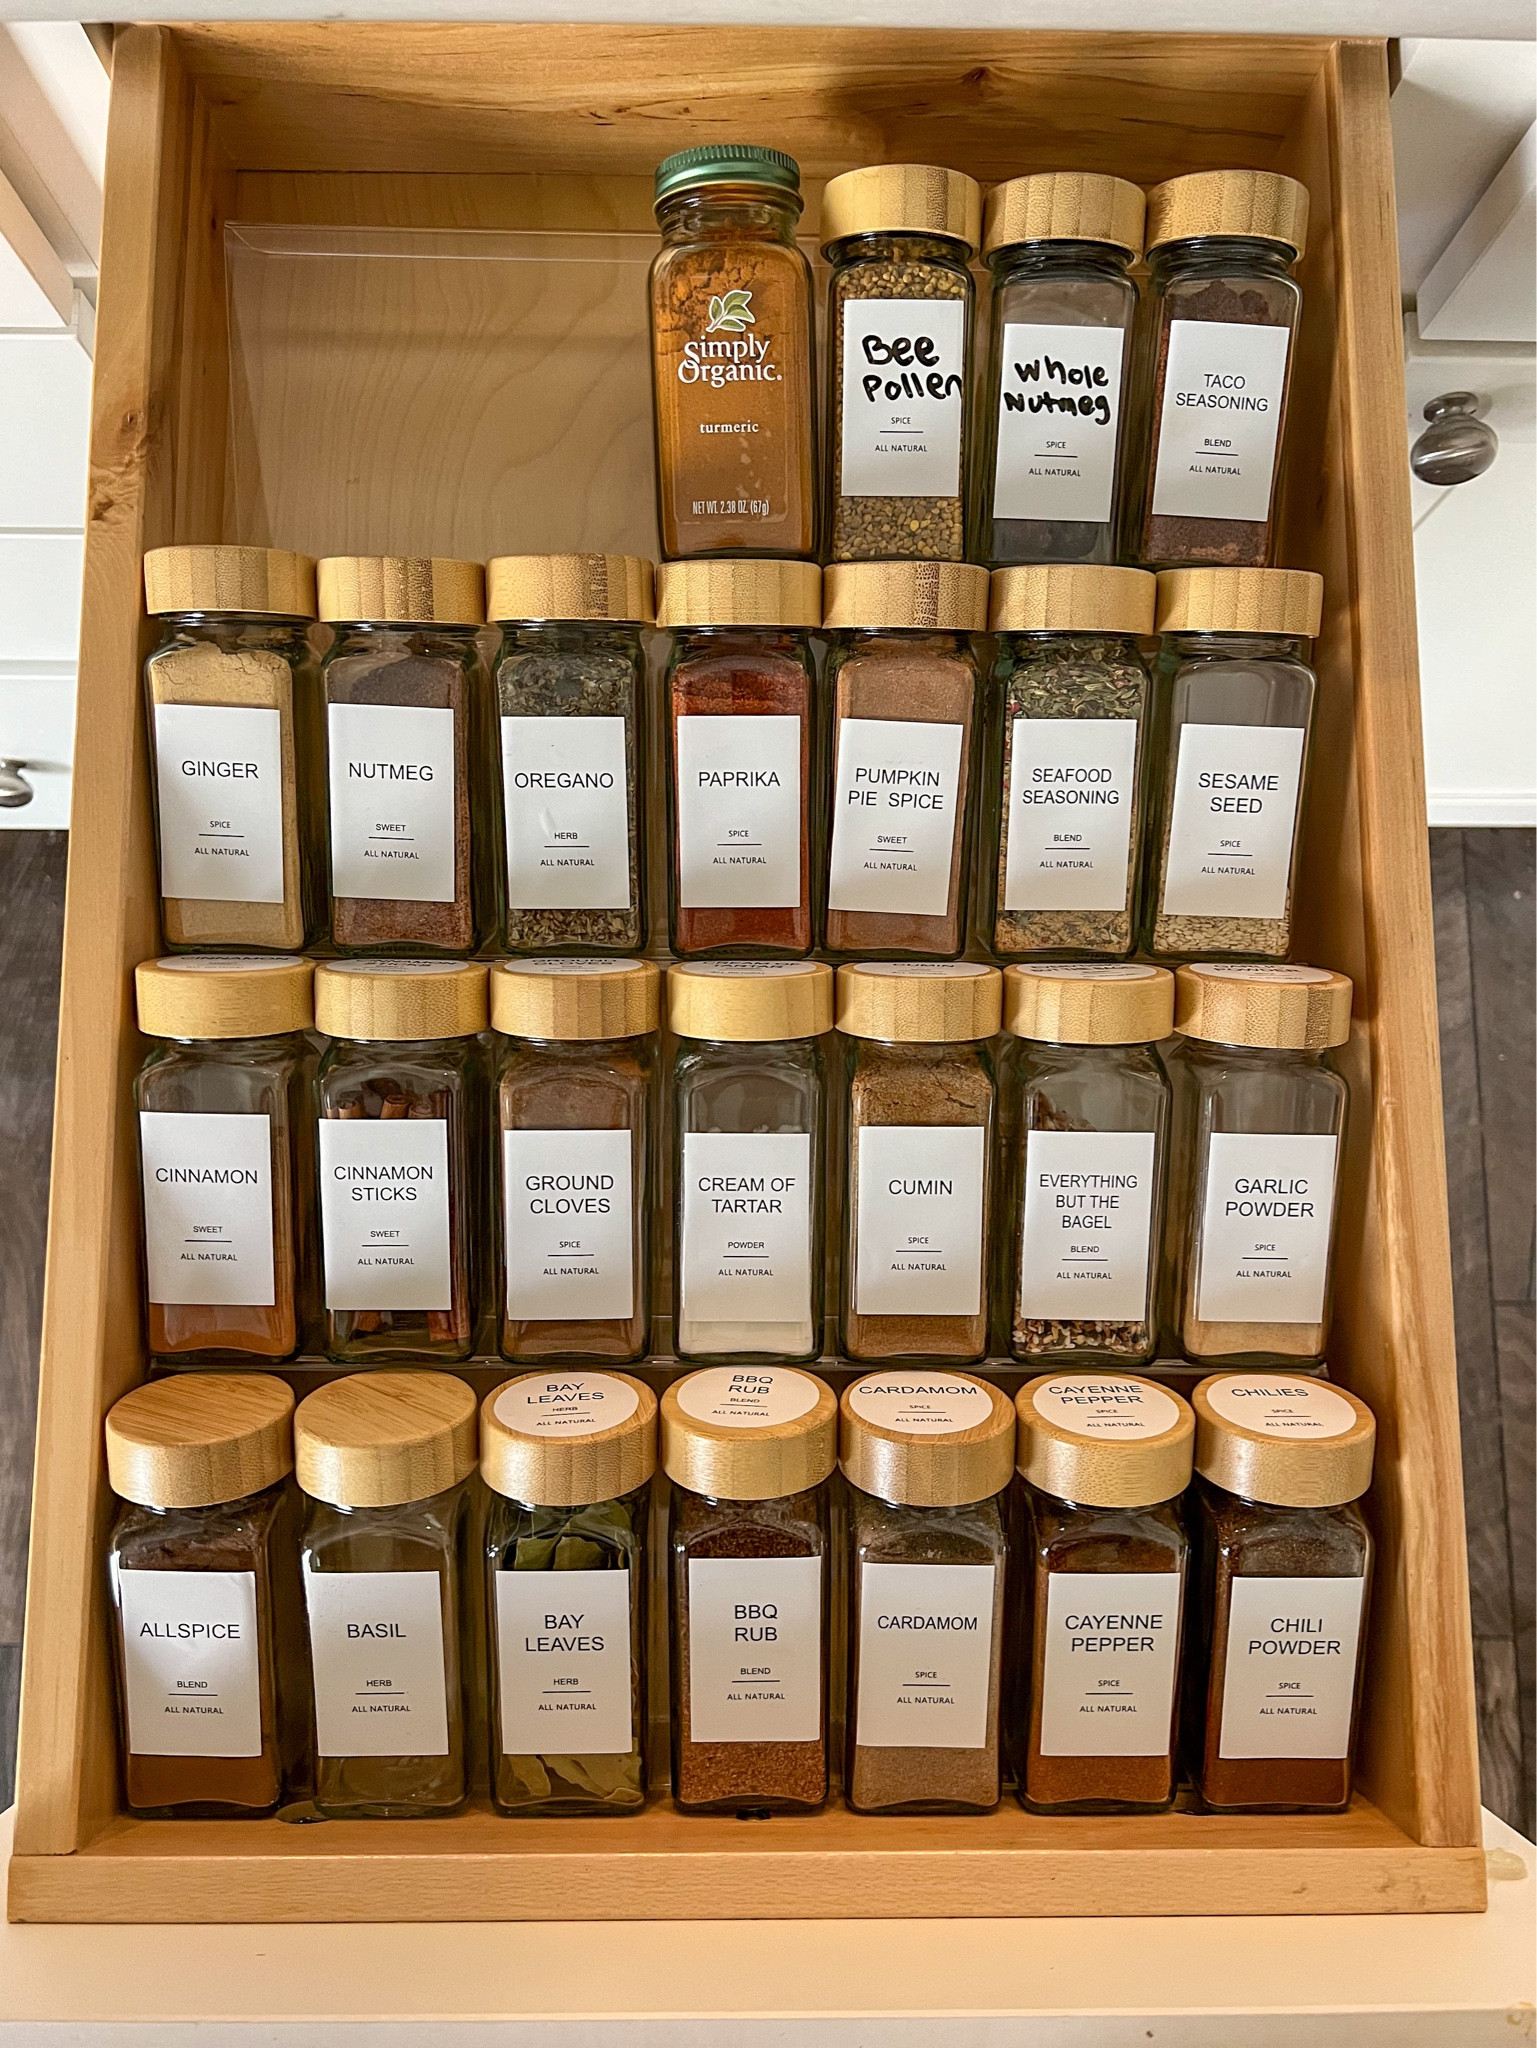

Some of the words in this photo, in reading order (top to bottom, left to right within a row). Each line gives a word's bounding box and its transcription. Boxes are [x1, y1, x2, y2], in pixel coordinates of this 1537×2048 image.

[684, 333, 770, 367] Simply
[862, 335, 940, 367] Bee
[1204, 374, 1245, 389] TACO
[862, 373, 963, 402] Pollen
[1176, 392, 1268, 411] SEASONING
[1003, 391, 1111, 425] Nutmeg
[890, 416, 912, 425] SPICE
[700, 420, 759, 435] turmeric
[1045, 440, 1067, 450] SPICE
[1203, 437, 1232, 448] BLEND
[874, 444, 889, 453] ALL
[890, 444, 928, 453] NATURAL
[1027, 467, 1043, 476] ALL
[1044, 467, 1082, 478] NATURAL
[1188, 464, 1204, 474] ALL
[1204, 465, 1242, 476] NATURAL
[692, 500, 705, 515] NET
[720, 499, 737, 514] 2.38
[750, 499, 770, 516] (67g)
[182, 760, 259, 779] GINGER
[349, 762, 433, 781] NUTMEG
[515, 773, 613, 788] OREGANO
[699, 771, 780, 787] PAPRIKA
[856, 768, 939, 786] PUMPKIN
[1032, 768, 1112, 783] SEAFOOD
[1198, 773, 1279, 790] SESAME
[848, 790, 877, 806] PIE
[888, 792, 943, 809] SPICE
[1022, 790, 1119, 804] SEASONING
[1210, 797, 1262, 813] SEED
[209, 820, 232, 829] SPICE
[375, 822, 407, 833] SWEET
[553, 831, 579, 840] HERB
[727, 829, 750, 838] SPICE
[1053, 833, 1083, 843] BLEND
[876, 834, 908, 845] SWEET
[1219, 839, 1242, 848] SPICE
[193, 846, 210, 856] ALL
[210, 847, 251, 857] NATURAL
[363, 849, 379, 858] ALL
[380, 850, 420, 860] NATURAL
[539, 858, 555, 867] ALL
[556, 858, 596, 867] NATURAL
[712, 856, 728, 865] ALL
[729, 856, 768, 865] NATURAL
[1039, 860, 1055, 869] ALL
[1055, 860, 1094, 869] NATURAL
[863, 861, 878, 870] ALL
[879, 862, 918, 872] NATURAL
[1200, 865, 1216, 874] ALL
[1217, 866, 1256, 876] NATURAL
[156, 1168, 257, 1184] CINNAMON
[334, 1166, 432, 1180] CINNAMON
[526, 1175, 614, 1191] GROUND
[699, 1177, 764, 1192] CREAM
[771, 1178, 796, 1192] OF
[1040, 1174, 1137, 1188] EVERYTHING
[1235, 1178, 1308, 1194] GARLIC
[889, 1180, 952, 1195] CUMIN
[352, 1187, 417, 1201] STICKS
[530, 1198, 610, 1214] CLOVES
[711, 1199, 782, 1213] TARTAR
[1056, 1195, 1086, 1208] BUT
[1089, 1195, 1119, 1208] THE
[1225, 1201, 1314, 1217] POWDER
[1062, 1215, 1112, 1229] BAGEL
[192, 1225, 223, 1234] SWEET
[369, 1230, 401, 1238] SWEET
[558, 1240, 581, 1249] SPICE
[727, 1241, 765, 1250] POWDER
[907, 1236, 929, 1245] SPICE
[1069, 1245, 1100, 1254] BLEND
[1253, 1243, 1276, 1252] SPICE
[179, 1252, 196, 1261] ALL
[197, 1252, 239, 1262] NATURAL
[357, 1257, 373, 1266] ALL
[374, 1257, 416, 1266] NATURAL
[542, 1267, 559, 1276] ALL
[559, 1267, 600, 1276] NATURAL
[717, 1268, 734, 1277] ALL
[734, 1268, 775, 1277] NATURAL
[890, 1263, 906, 1271] ALL
[907, 1262, 948, 1272] NATURAL
[1055, 1271, 1072, 1280] ALL
[1073, 1271, 1113, 1280] NATURAL
[1235, 1269, 1252, 1278] ALL
[1252, 1270, 1292, 1279] NATURAL
[731, 1374, 774, 1385] BBQ
[546, 1382, 585, 1393] BAY
[727, 1384, 770, 1395] RUB
[858, 1385, 978, 1395] CARDAMOM
[1048, 1384, 1144, 1395] CAYENNE
[1230, 1388, 1310, 1397] CHILIES
[527, 1392, 604, 1404] LEAVES
[1060, 1395, 1145, 1405] PEPPER
[735, 1604, 778, 1619] BBQ
[545, 1614, 584, 1629] BAY
[878, 1615, 977, 1630] CARDAMOM
[1065, 1615, 1163, 1630] CAYENNE
[1271, 1618, 1322, 1633] CHILI
[140, 1623, 240, 1639] ALLSPICE
[347, 1623, 406, 1638] BASIL
[735, 1627, 777, 1642] RUB
[525, 1636, 604, 1652] LEAVES
[1072, 1637, 1154, 1652] PEPPER
[1249, 1640, 1341, 1655] POWDER
[739, 1666, 772, 1676] BLEND
[914, 1670, 938, 1679] SPICE
[176, 1680, 209, 1689] BLEND
[365, 1679, 393, 1688] HERB
[552, 1677, 580, 1686] HERB
[1097, 1679, 1121, 1688] SPICE
[1278, 1681, 1302, 1690] SPICE
[726, 1693, 743, 1701] ALL
[744, 1692, 786, 1701] NATURAL
[896, 1696, 913, 1704] ALL
[914, 1696, 955, 1705] NATURAL
[163, 1705, 181, 1714] ALL
[181, 1706, 225, 1715] NATURAL
[351, 1705, 368, 1713] ALL
[369, 1704, 412, 1713] NATURAL
[537, 1703, 554, 1712] ALL
[555, 1703, 597, 1711] NATURAL
[1078, 1705, 1095, 1713] ALL
[1096, 1704, 1138, 1713] NATURAL
[1258, 1707, 1275, 1715] ALL
[1276, 1707, 1318, 1716] NATURAL
